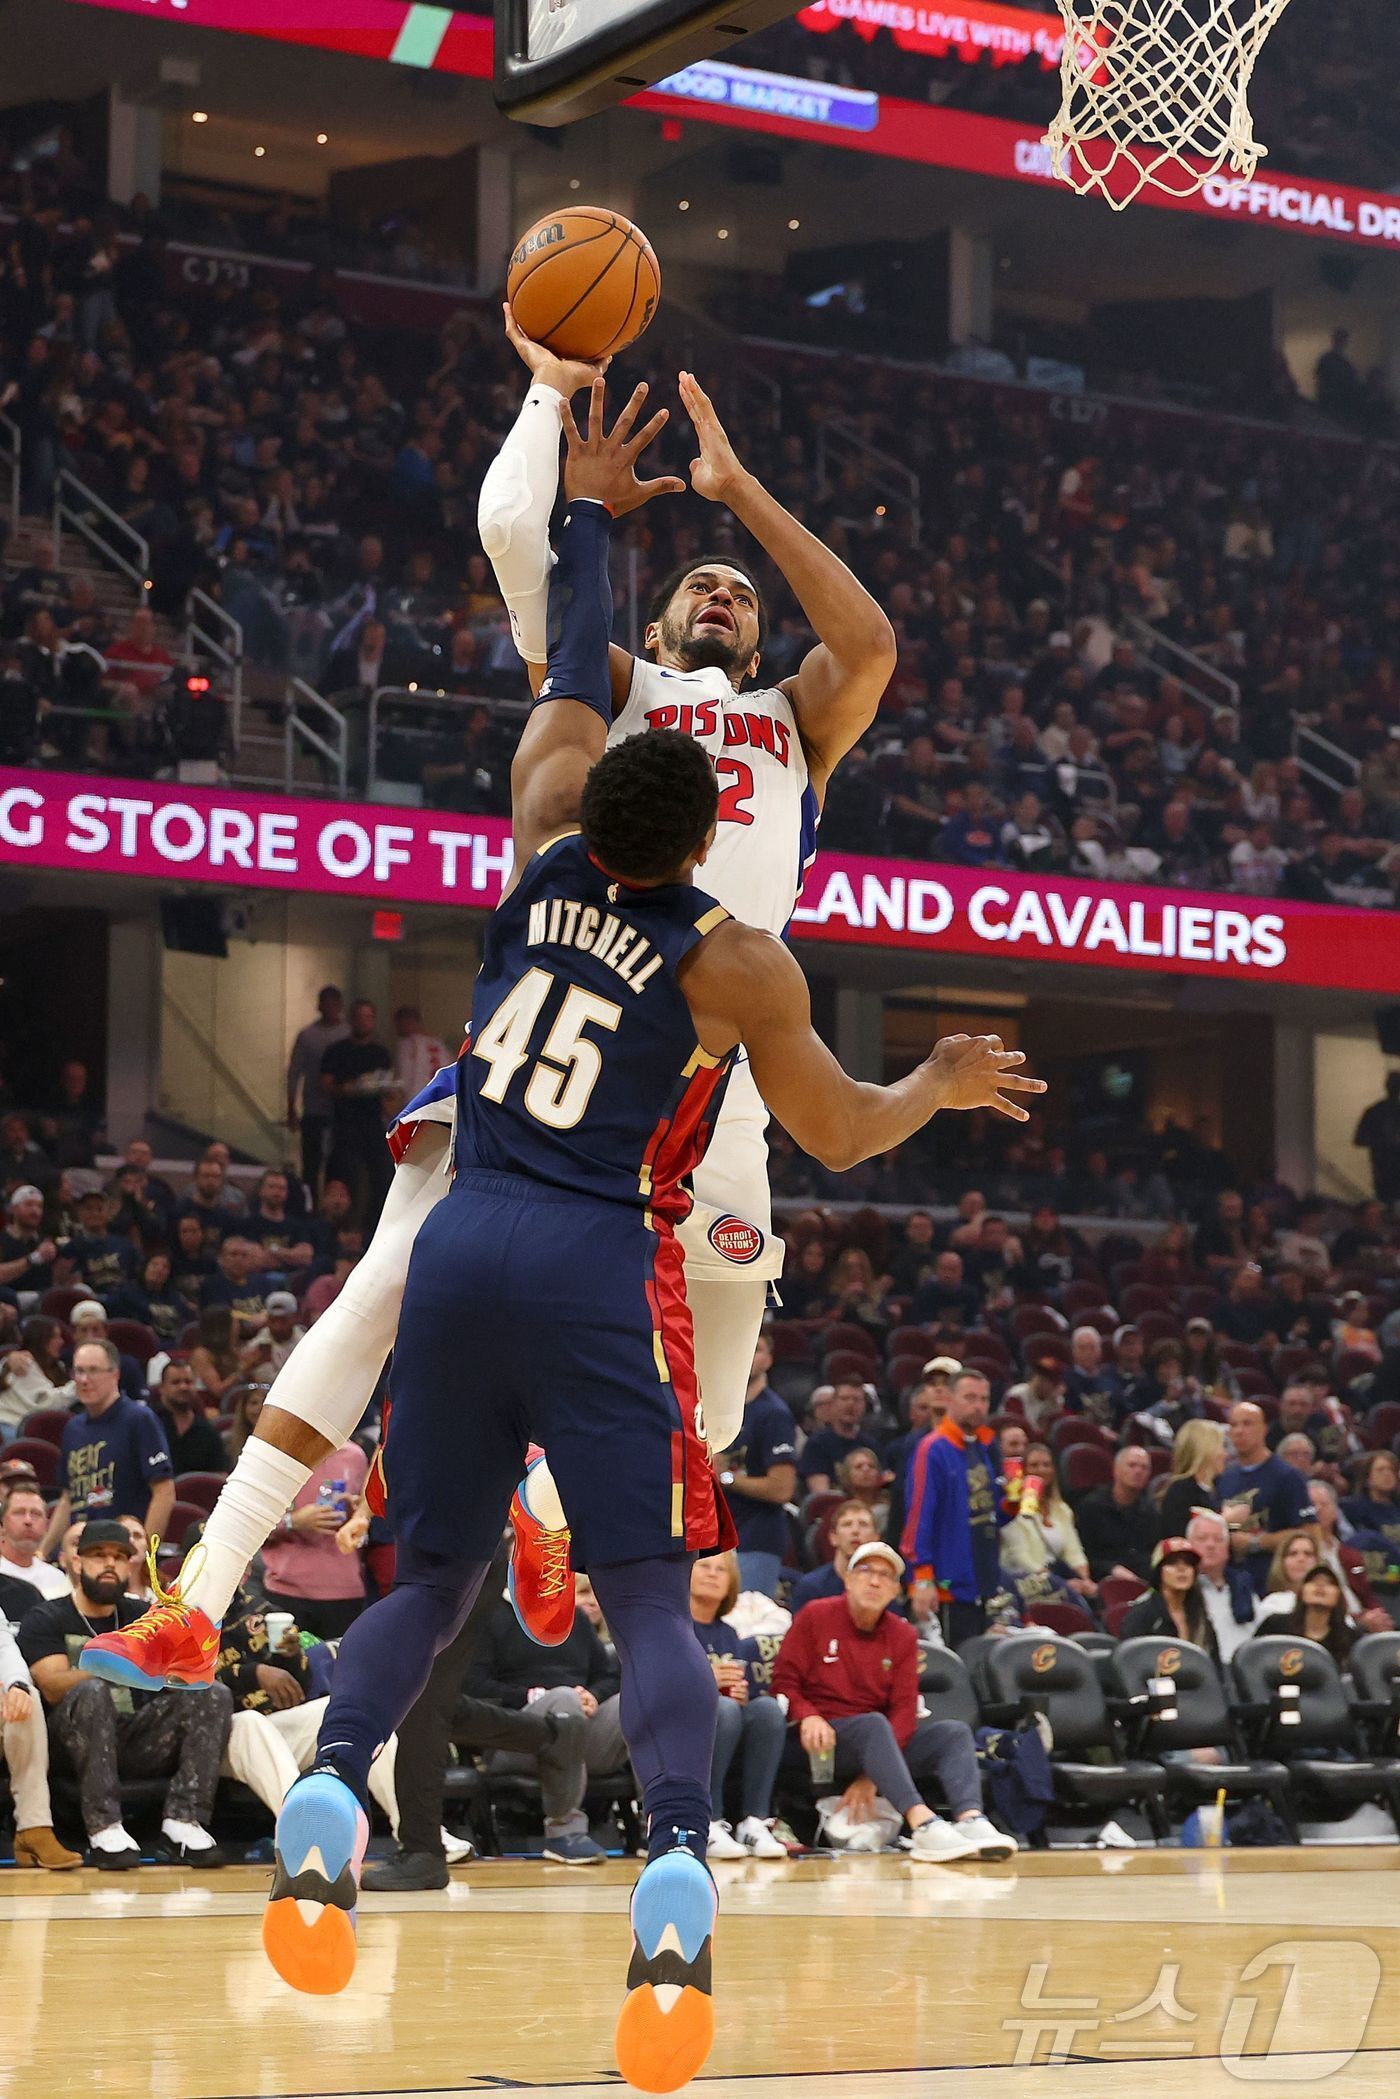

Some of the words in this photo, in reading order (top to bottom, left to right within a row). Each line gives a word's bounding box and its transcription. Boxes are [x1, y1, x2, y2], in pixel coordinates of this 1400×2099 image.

[917, 9, 968, 43] LIVE
[968, 21, 1031, 55] WITH
[729, 77, 834, 122] MARKET
[1201, 173, 1354, 232] OFFICIAL
[644, 698, 791, 769] PISONS
[708, 753, 755, 826] 2
[0, 786, 45, 848] G
[65, 792, 300, 874] STORE
[316, 819, 415, 882] OF
[428, 829, 515, 891] TH
[967, 885, 1287, 968] CAVALIERS
[526, 898, 665, 996] MITCHELL
[471, 966, 625, 1130] 45
[717, 1229, 752, 1243] DETROIT
[719, 1238, 754, 1249] PISTONS
